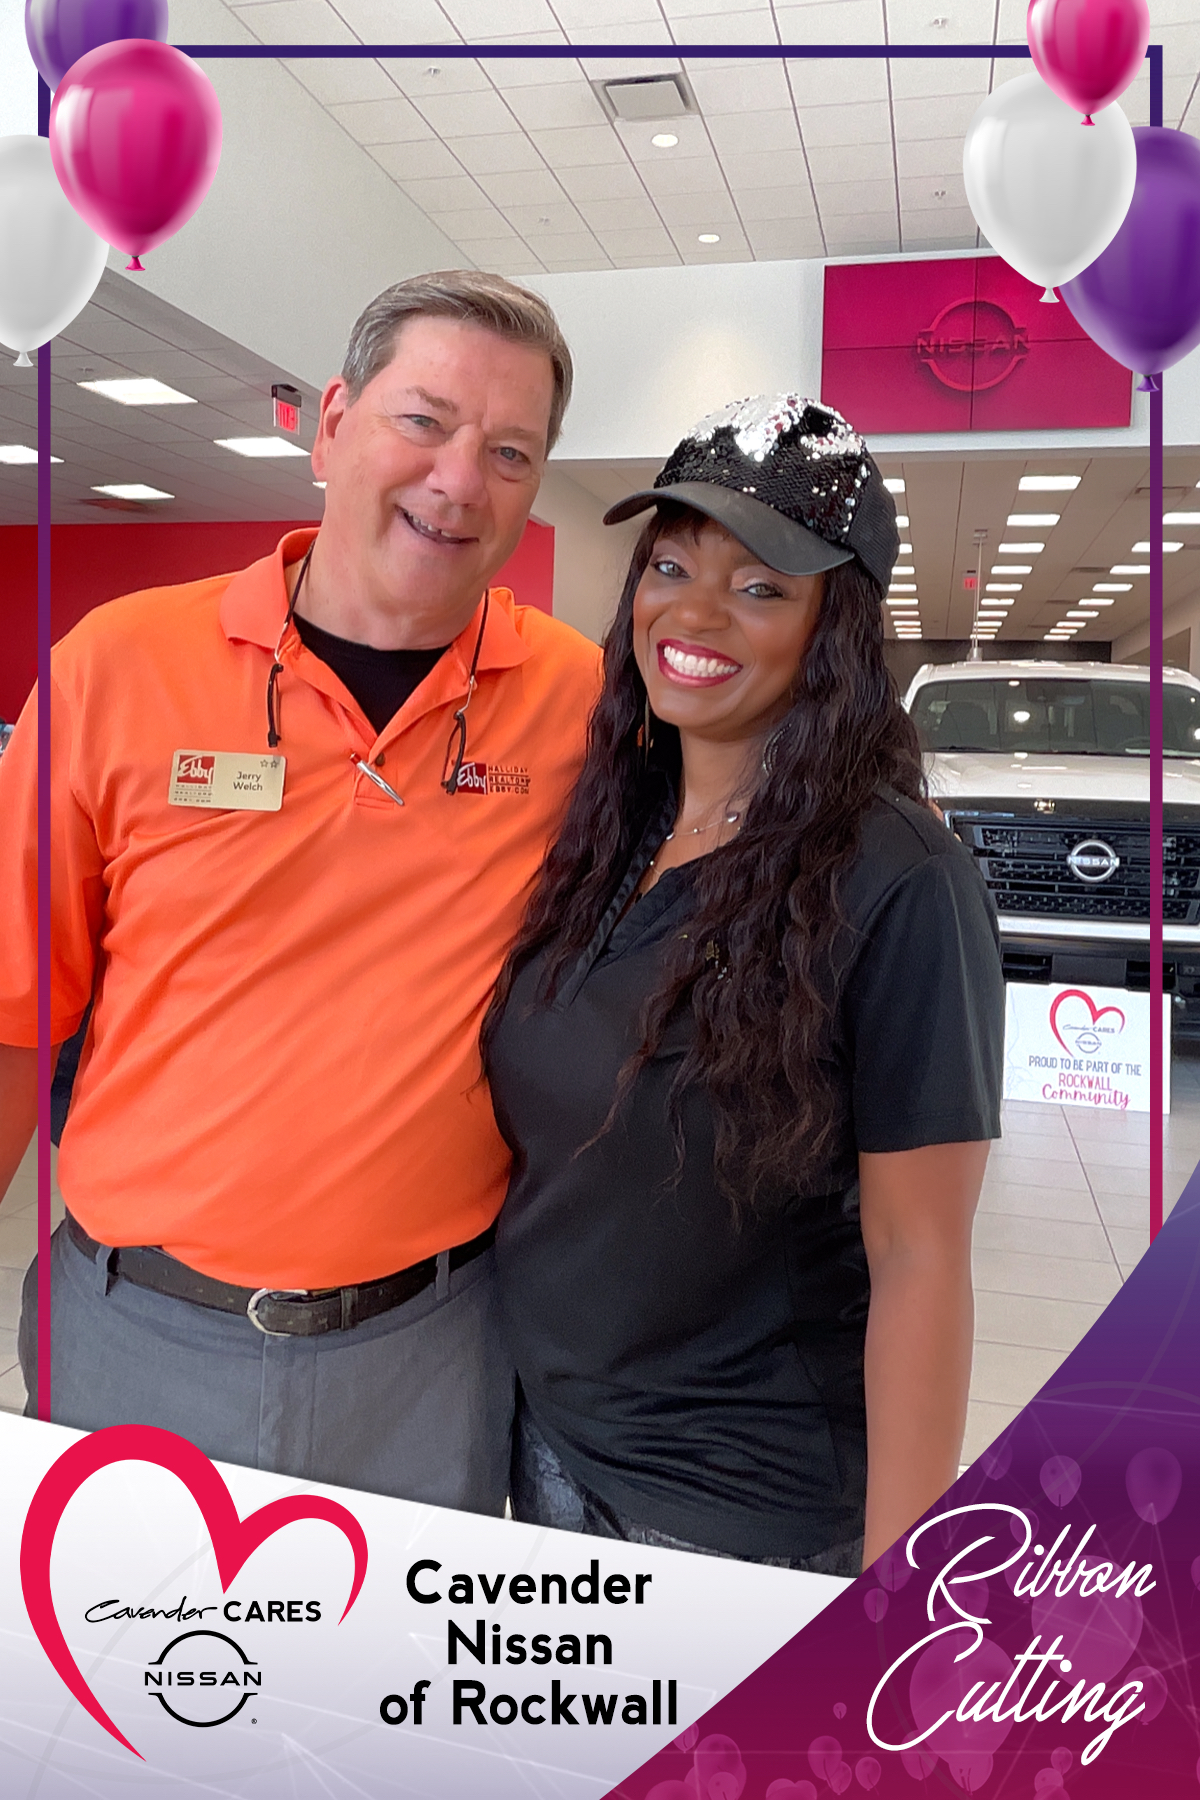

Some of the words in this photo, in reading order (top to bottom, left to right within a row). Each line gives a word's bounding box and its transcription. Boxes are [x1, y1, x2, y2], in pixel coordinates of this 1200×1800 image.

[916, 334, 1030, 354] NISSAN
[178, 755, 215, 784] Ebby
[236, 771, 261, 782] Jerry
[457, 762, 487, 794] Ebby
[233, 782, 263, 791] Welch
[1067, 855, 1120, 868] NISSAN
[1028, 1055, 1058, 1069] PROUD
[1060, 1058, 1071, 1070] TO
[1073, 1060, 1084, 1072] BE
[1086, 1061, 1109, 1073] PART
[1111, 1062, 1123, 1074] OF
[1125, 1063, 1142, 1076] THE
[1058, 1073, 1113, 1091] ROCKWALL
[1042, 1084, 1130, 1109] Community
